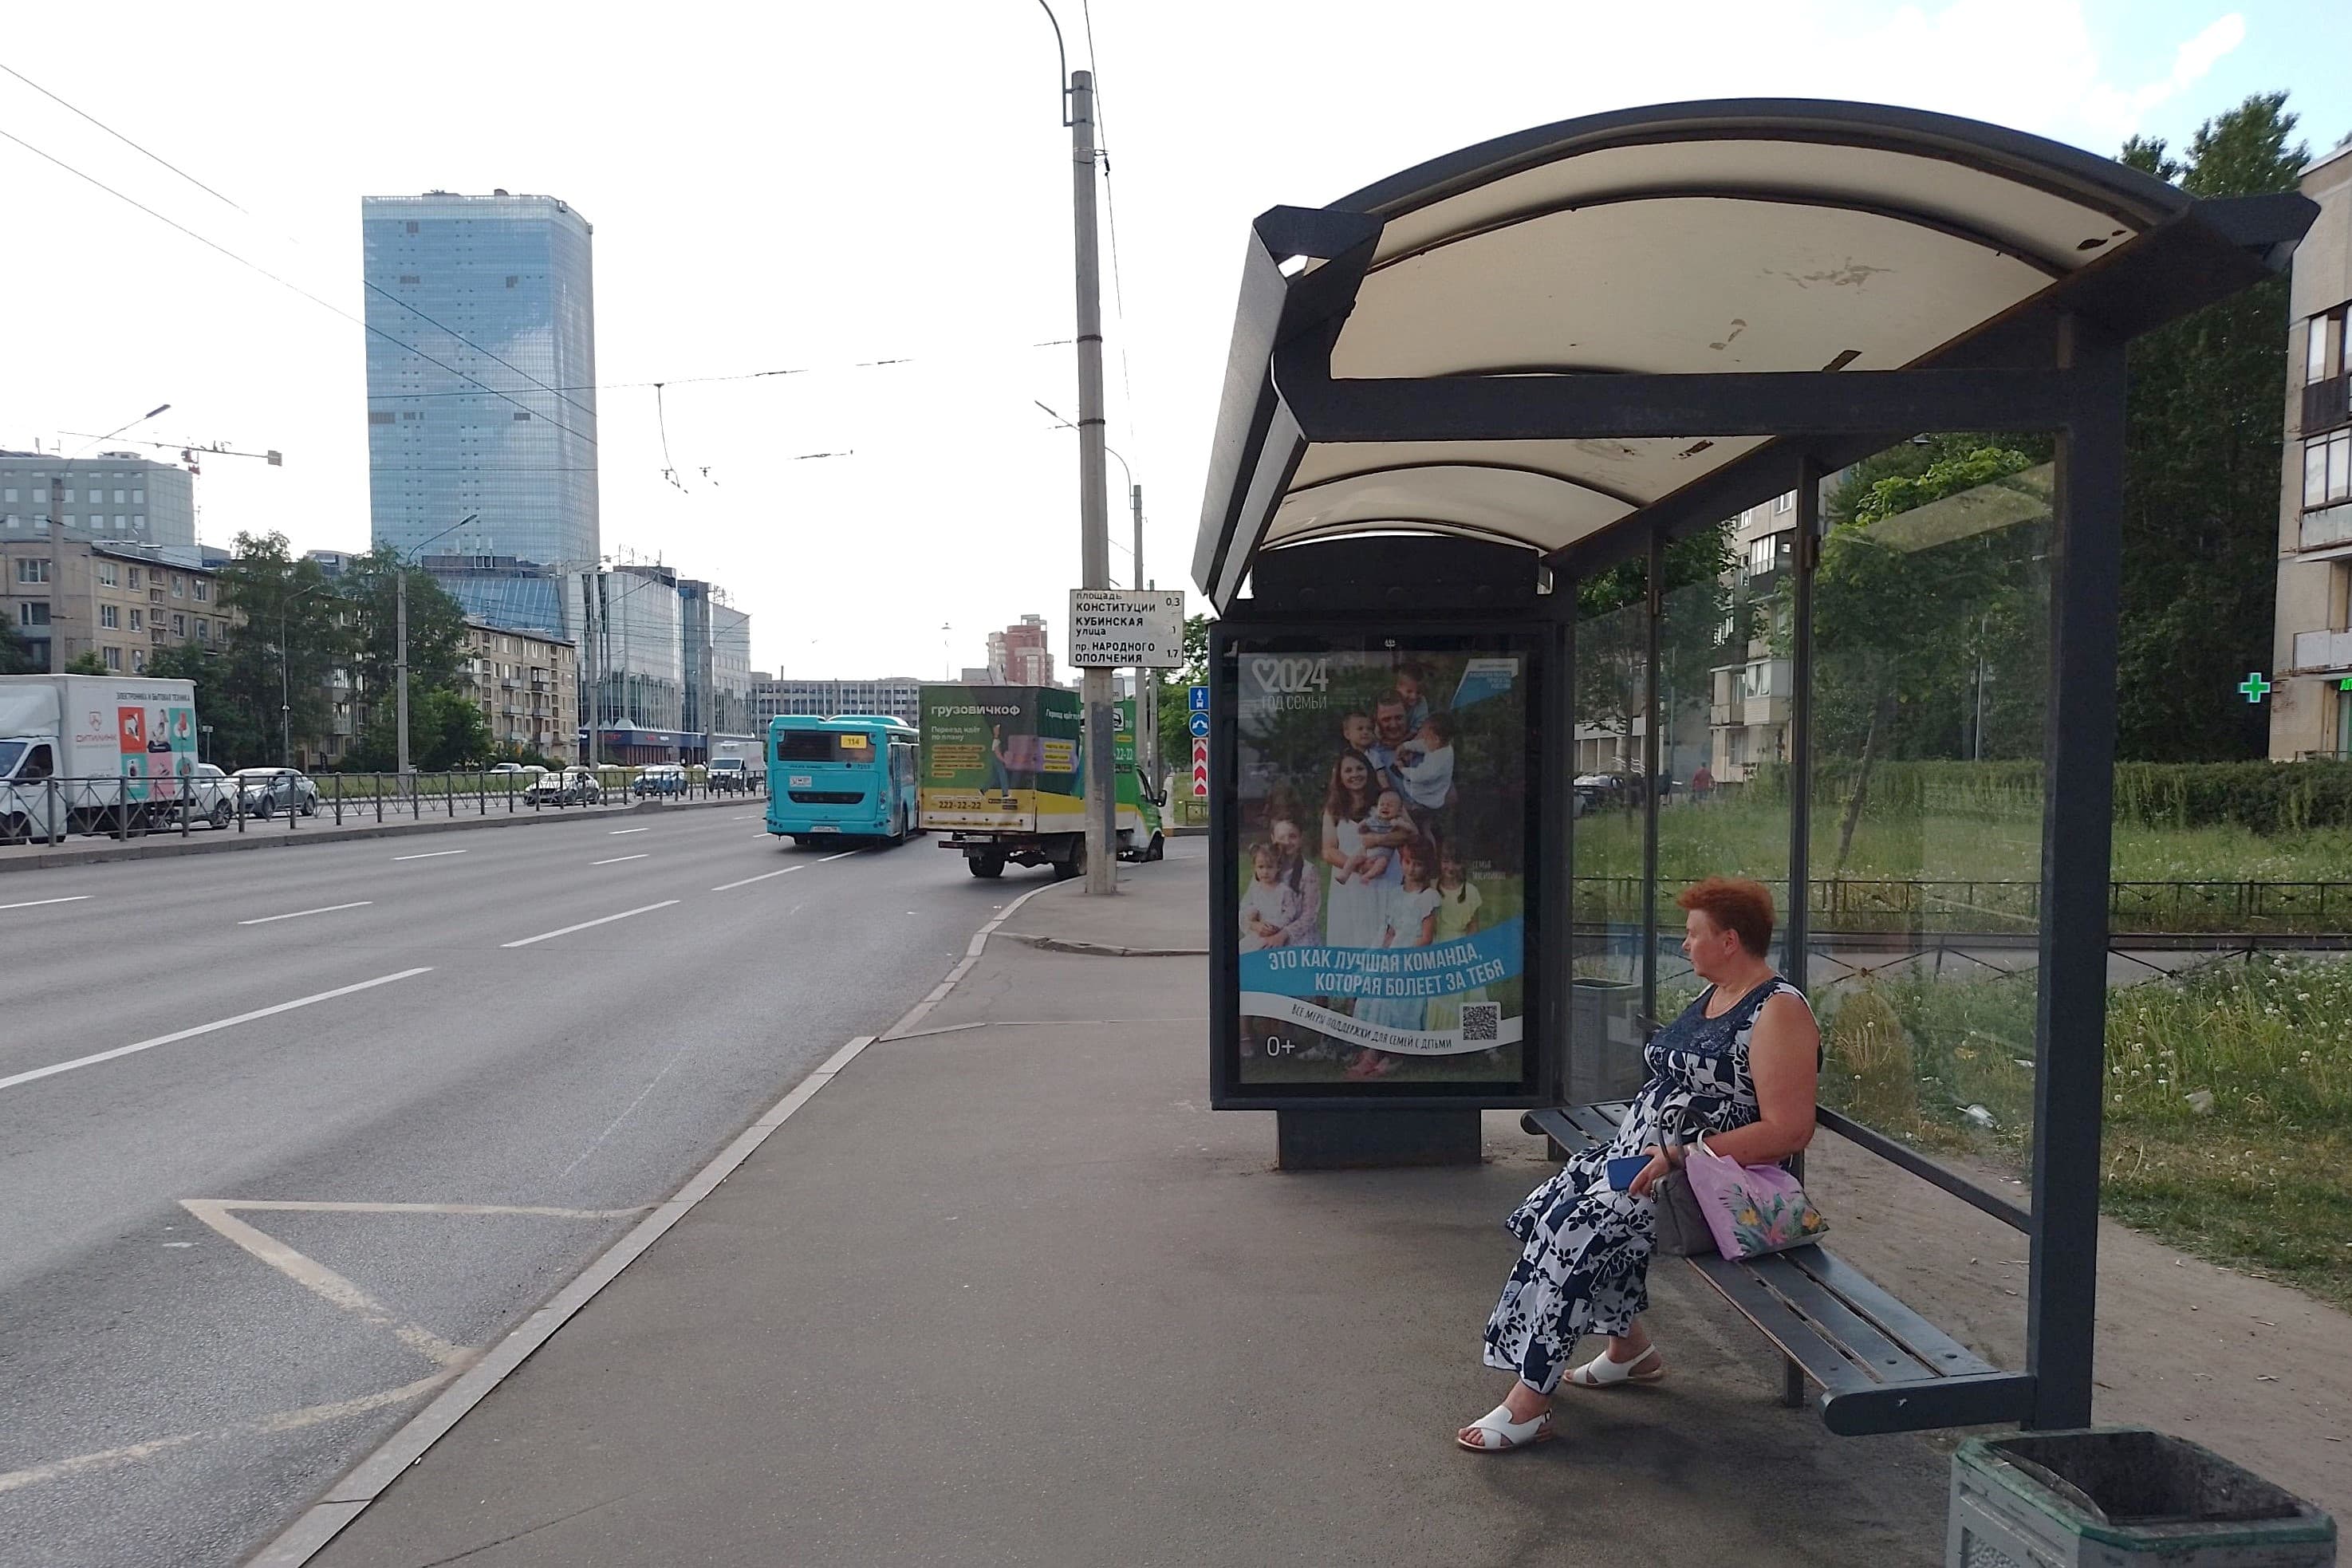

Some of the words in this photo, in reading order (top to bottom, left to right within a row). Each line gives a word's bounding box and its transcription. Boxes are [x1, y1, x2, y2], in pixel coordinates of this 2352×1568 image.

[1076, 603, 1156, 613] КОНСТИТУЦИИ
[1076, 617, 1144, 627] КУБИНСКАЯ
[1075, 628, 1107, 636] улица
[1172, 625, 1176, 634] 1
[1075, 644, 1089, 652] пр.
[1091, 642, 1156, 652] НАРОДНОГО
[1074, 653, 1143, 663] ОПОЛЧЕНИЯ
[1251, 658, 1329, 693] 2024
[939, 801, 982, 810] 222-22-22
[1268, 949, 1298, 971] ЭТО
[1301, 949, 1331, 968] КАК
[1334, 950, 1400, 973] ЛУЧШАЯ
[1402, 942, 1483, 971] КОМАНДА,
[1315, 972, 1382, 996] КОТОРАЯ
[1385, 975, 1442, 997] БОЛЕЕТ
[1445, 972, 1466, 991] ЗА
[1466, 958, 1506, 986] ТЕБЯ
[1290, 1003, 1305, 1018] ВСЕ
[1370, 1030, 1389, 1044] ДЛЯ
[1389, 1034, 1414, 1048] СЕМЕЙ
[1420, 1038, 1453, 1050] ДЕТЬМИ
[1267, 1035, 1296, 1057] 0+
